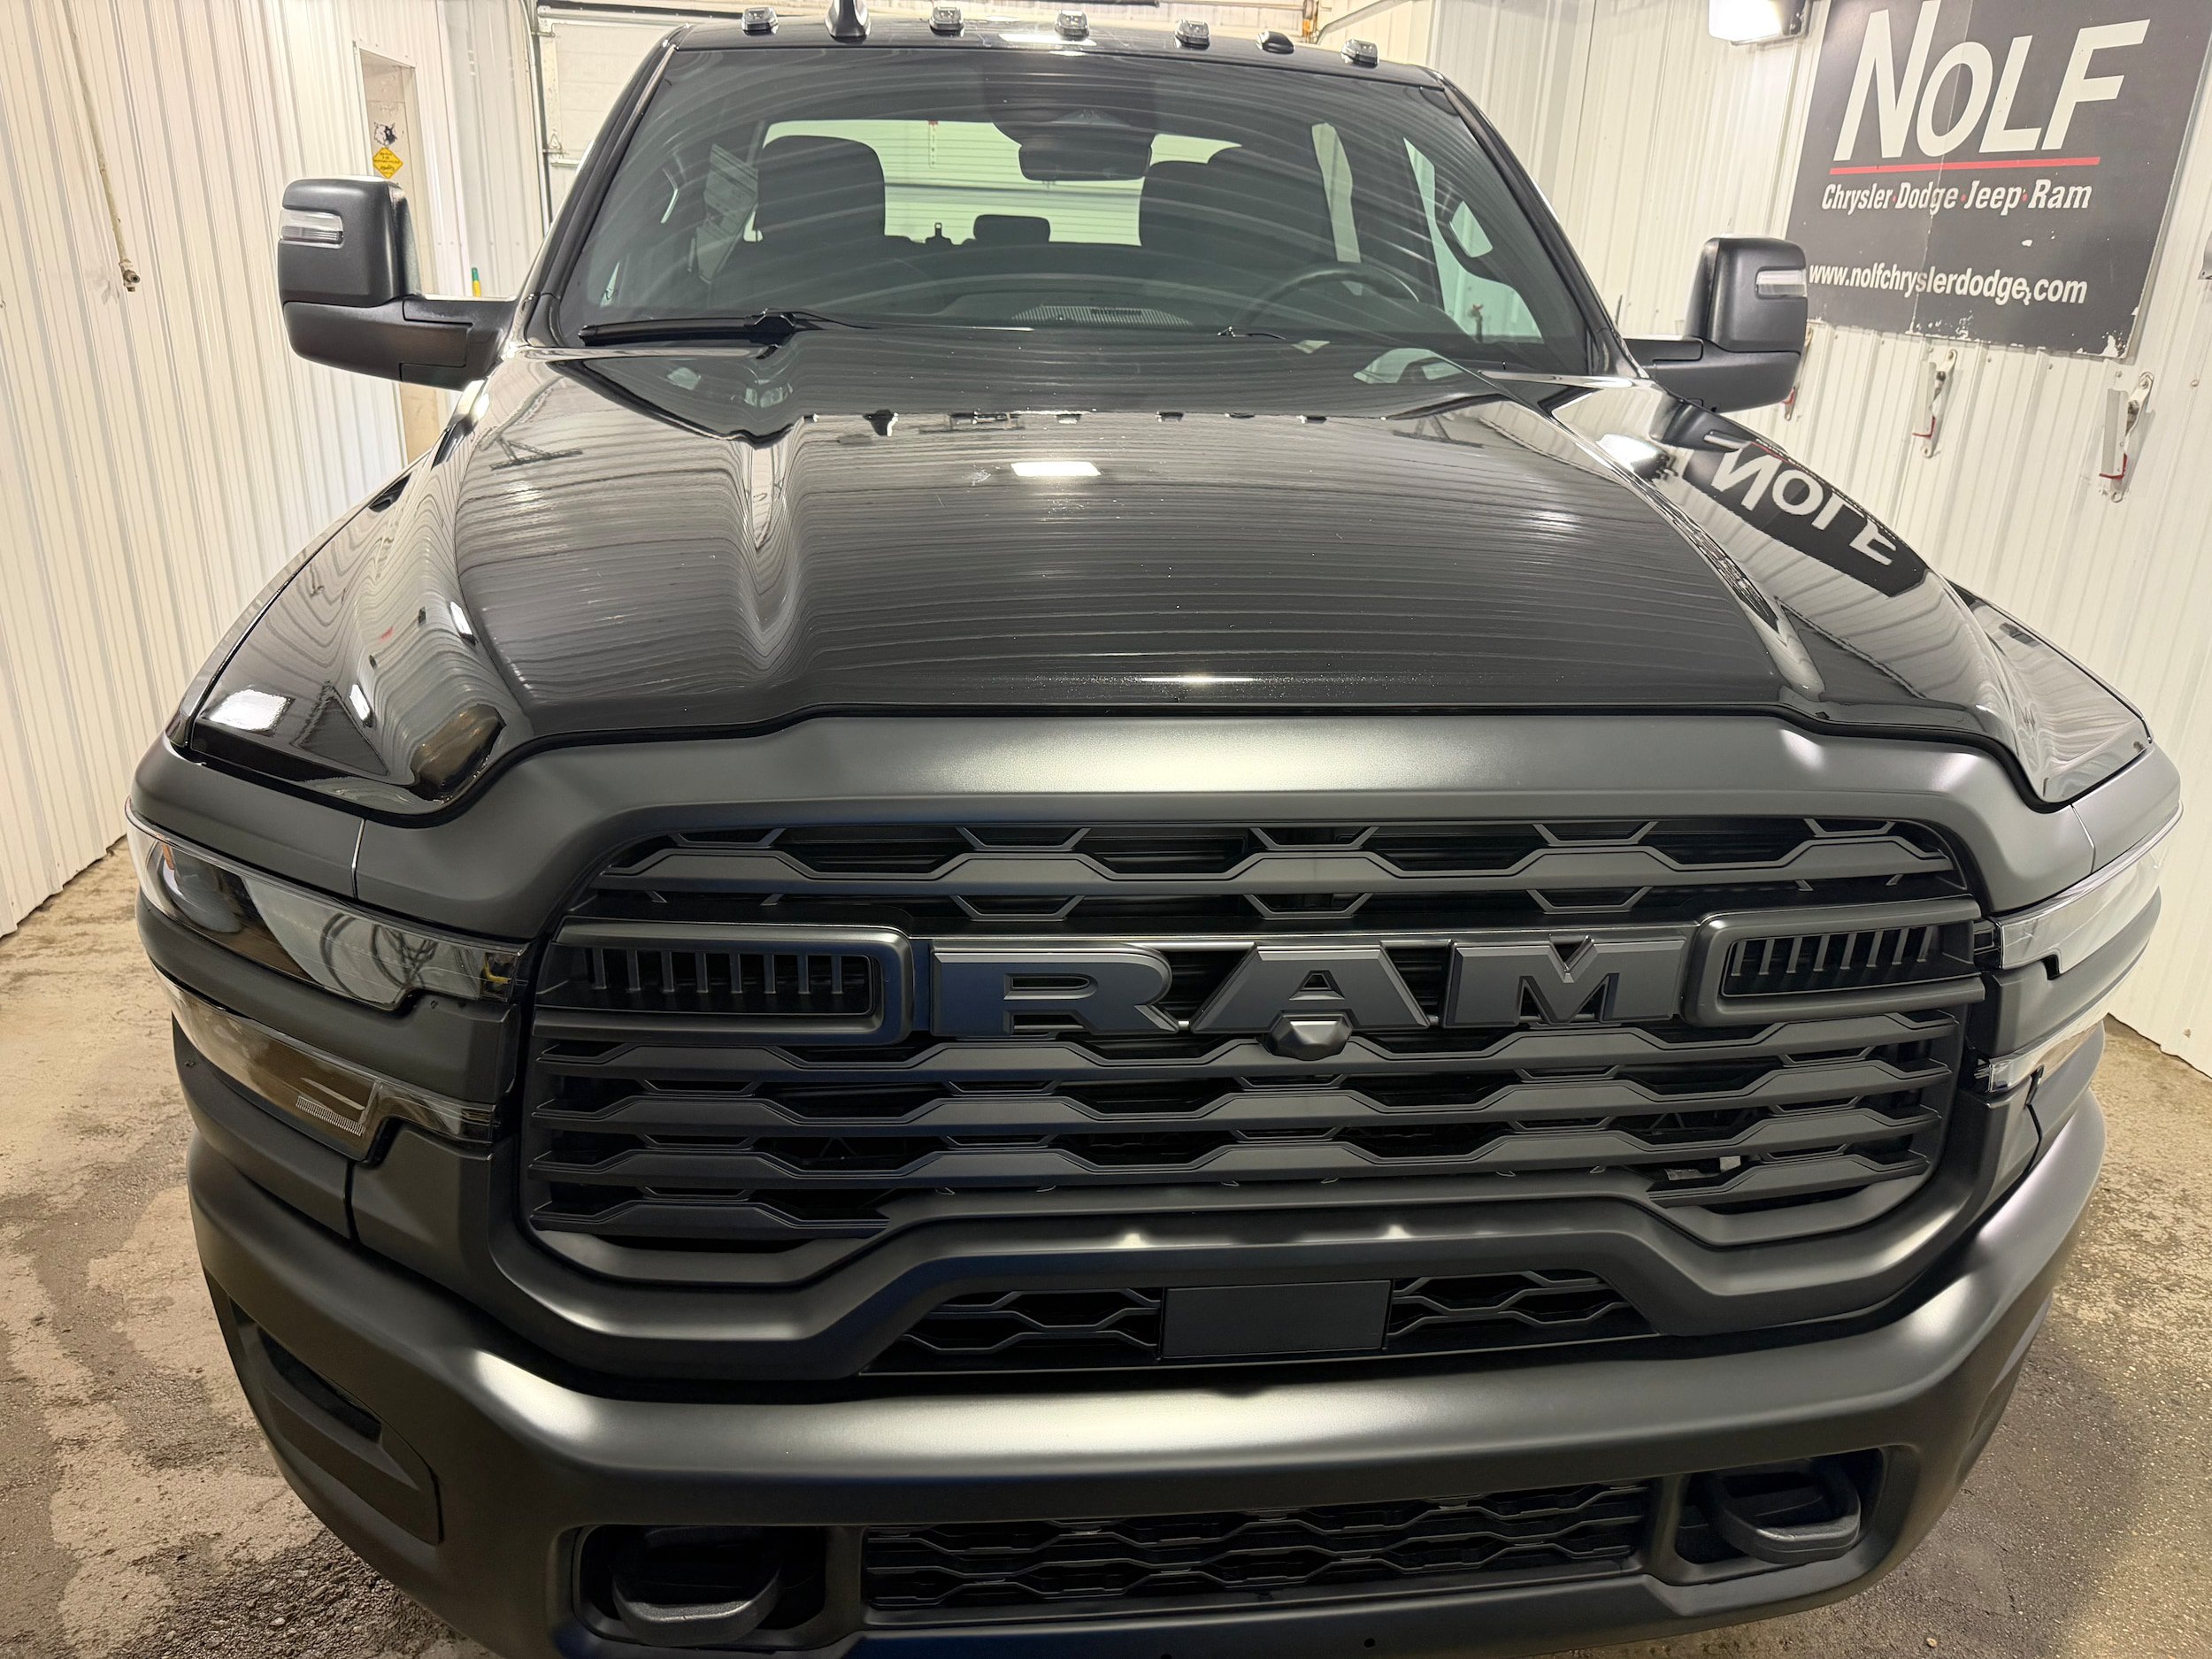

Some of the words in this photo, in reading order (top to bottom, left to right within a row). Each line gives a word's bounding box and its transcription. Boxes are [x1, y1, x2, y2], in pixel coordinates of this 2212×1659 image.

[1833, 0, 2150, 161] NOLF
[1821, 183, 1893, 215] Chrysler
[1894, 181, 1959, 216] Dodge
[1963, 180, 2024, 216] Jeep
[2027, 179, 2093, 209] Ram
[1809, 262, 2088, 305] www.nolfchryslerdodge.com
[931, 936, 1688, 1039] RAM
